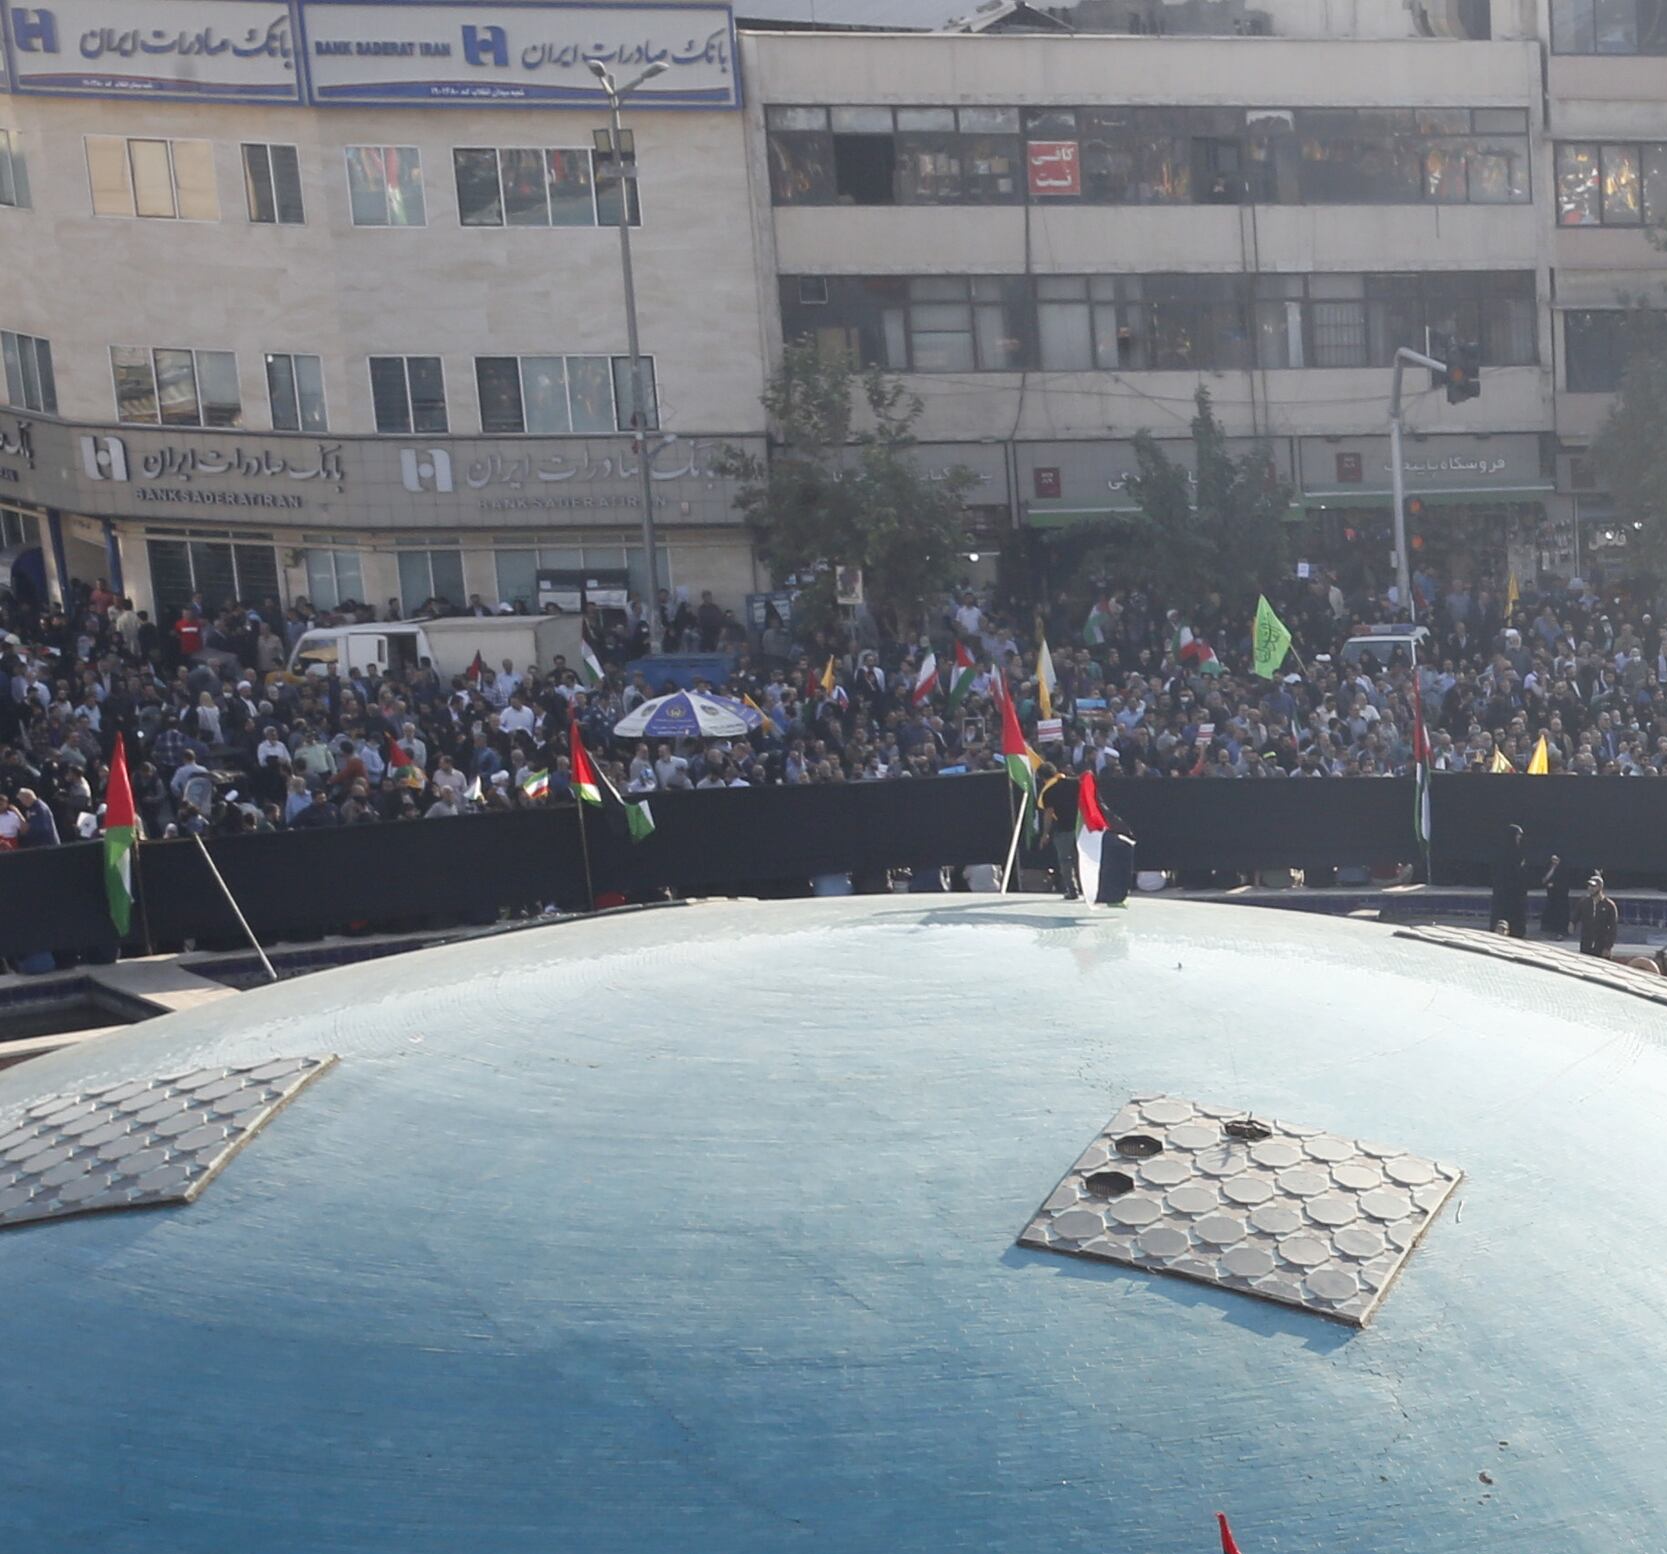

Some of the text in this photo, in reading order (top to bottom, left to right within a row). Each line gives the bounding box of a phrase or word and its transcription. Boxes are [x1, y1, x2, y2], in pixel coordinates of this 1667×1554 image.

[80, 28, 140, 59] ایران
[315, 40, 451, 57] BANK SADERAT IRAN
[521, 40, 579, 70] ایران
[672, 28, 727, 73] بانک
[1031, 147, 1075, 165] کافی
[1035, 168, 1072, 187] نت
[143, 445, 195, 482] ایران
[289, 445, 345, 493] بانک
[465, 453, 530, 489] ایران
